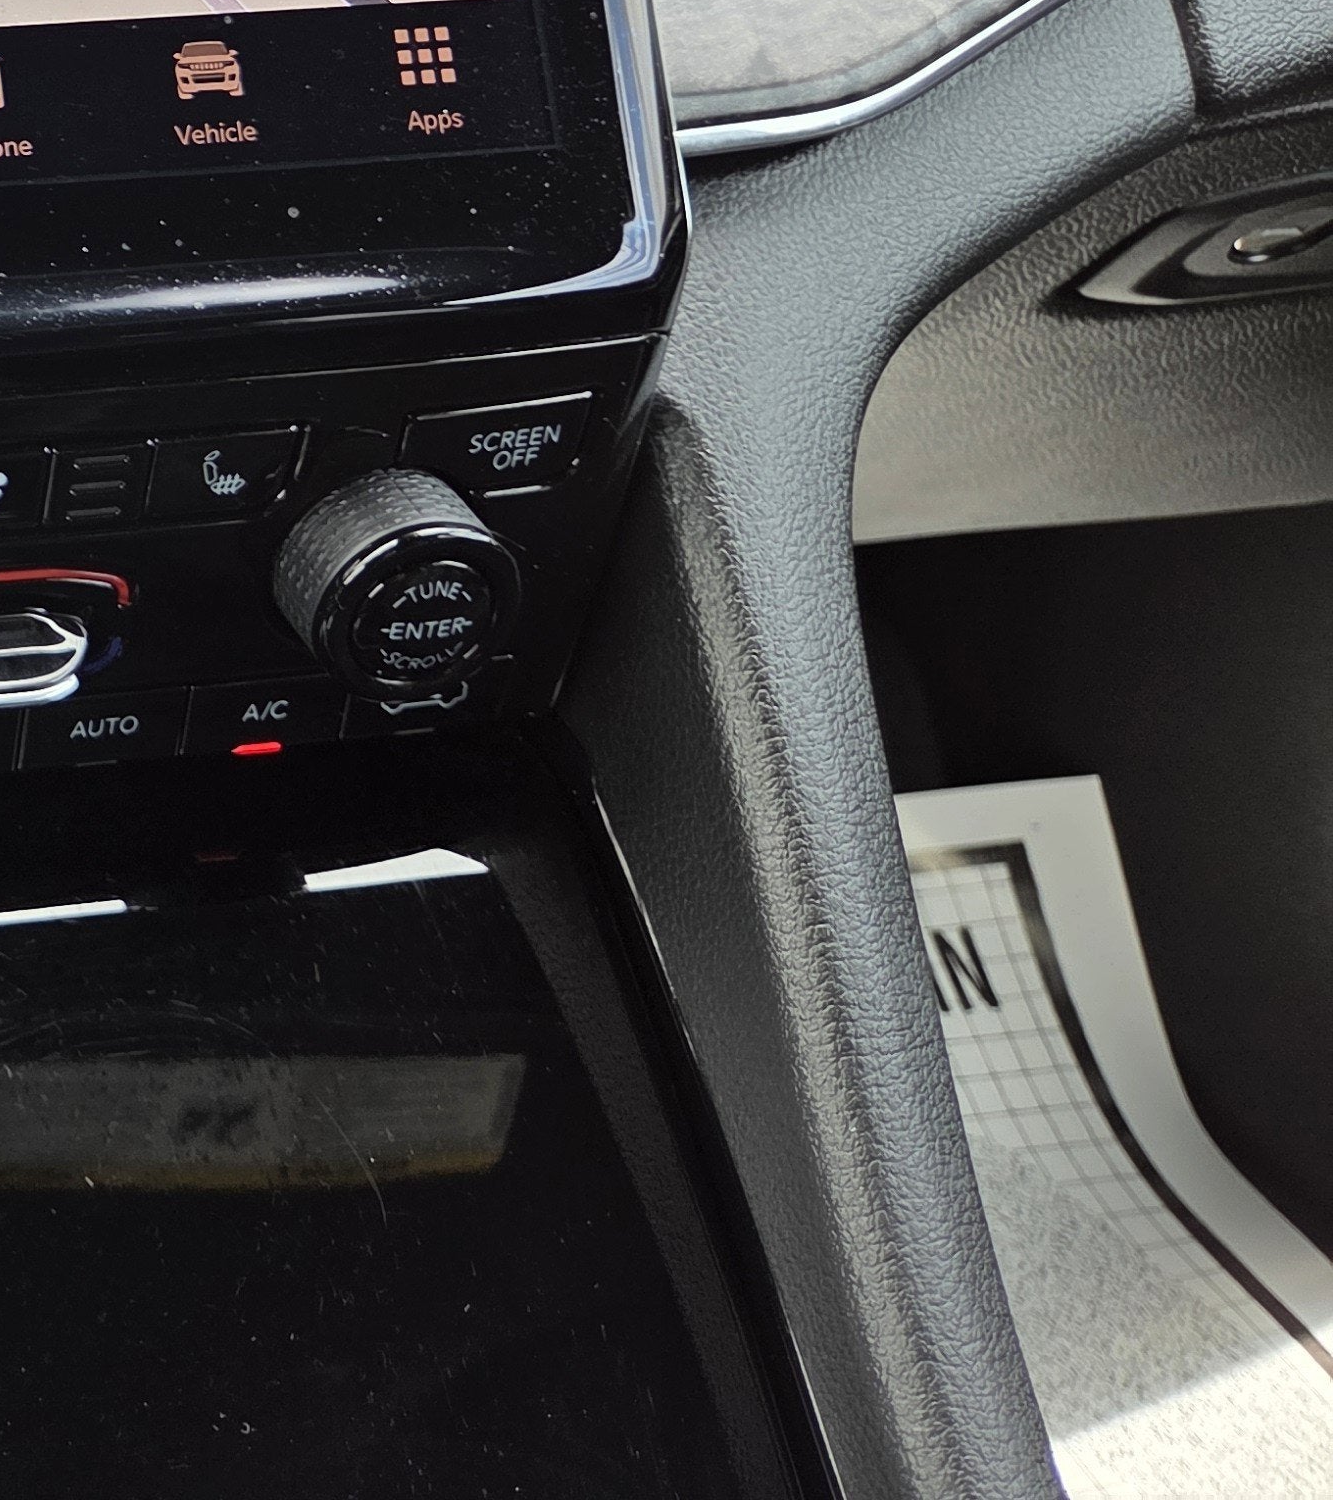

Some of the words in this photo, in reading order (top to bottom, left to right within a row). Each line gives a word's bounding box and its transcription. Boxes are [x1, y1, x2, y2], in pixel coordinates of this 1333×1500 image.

[174, 118, 257, 146] Vehicle
[407, 108, 464, 135] Apps
[468, 423, 562, 454] SCREEN
[492, 448, 539, 471] OFF
[241, 700, 289, 721] A/C
[70, 716, 139, 740] AUTO
